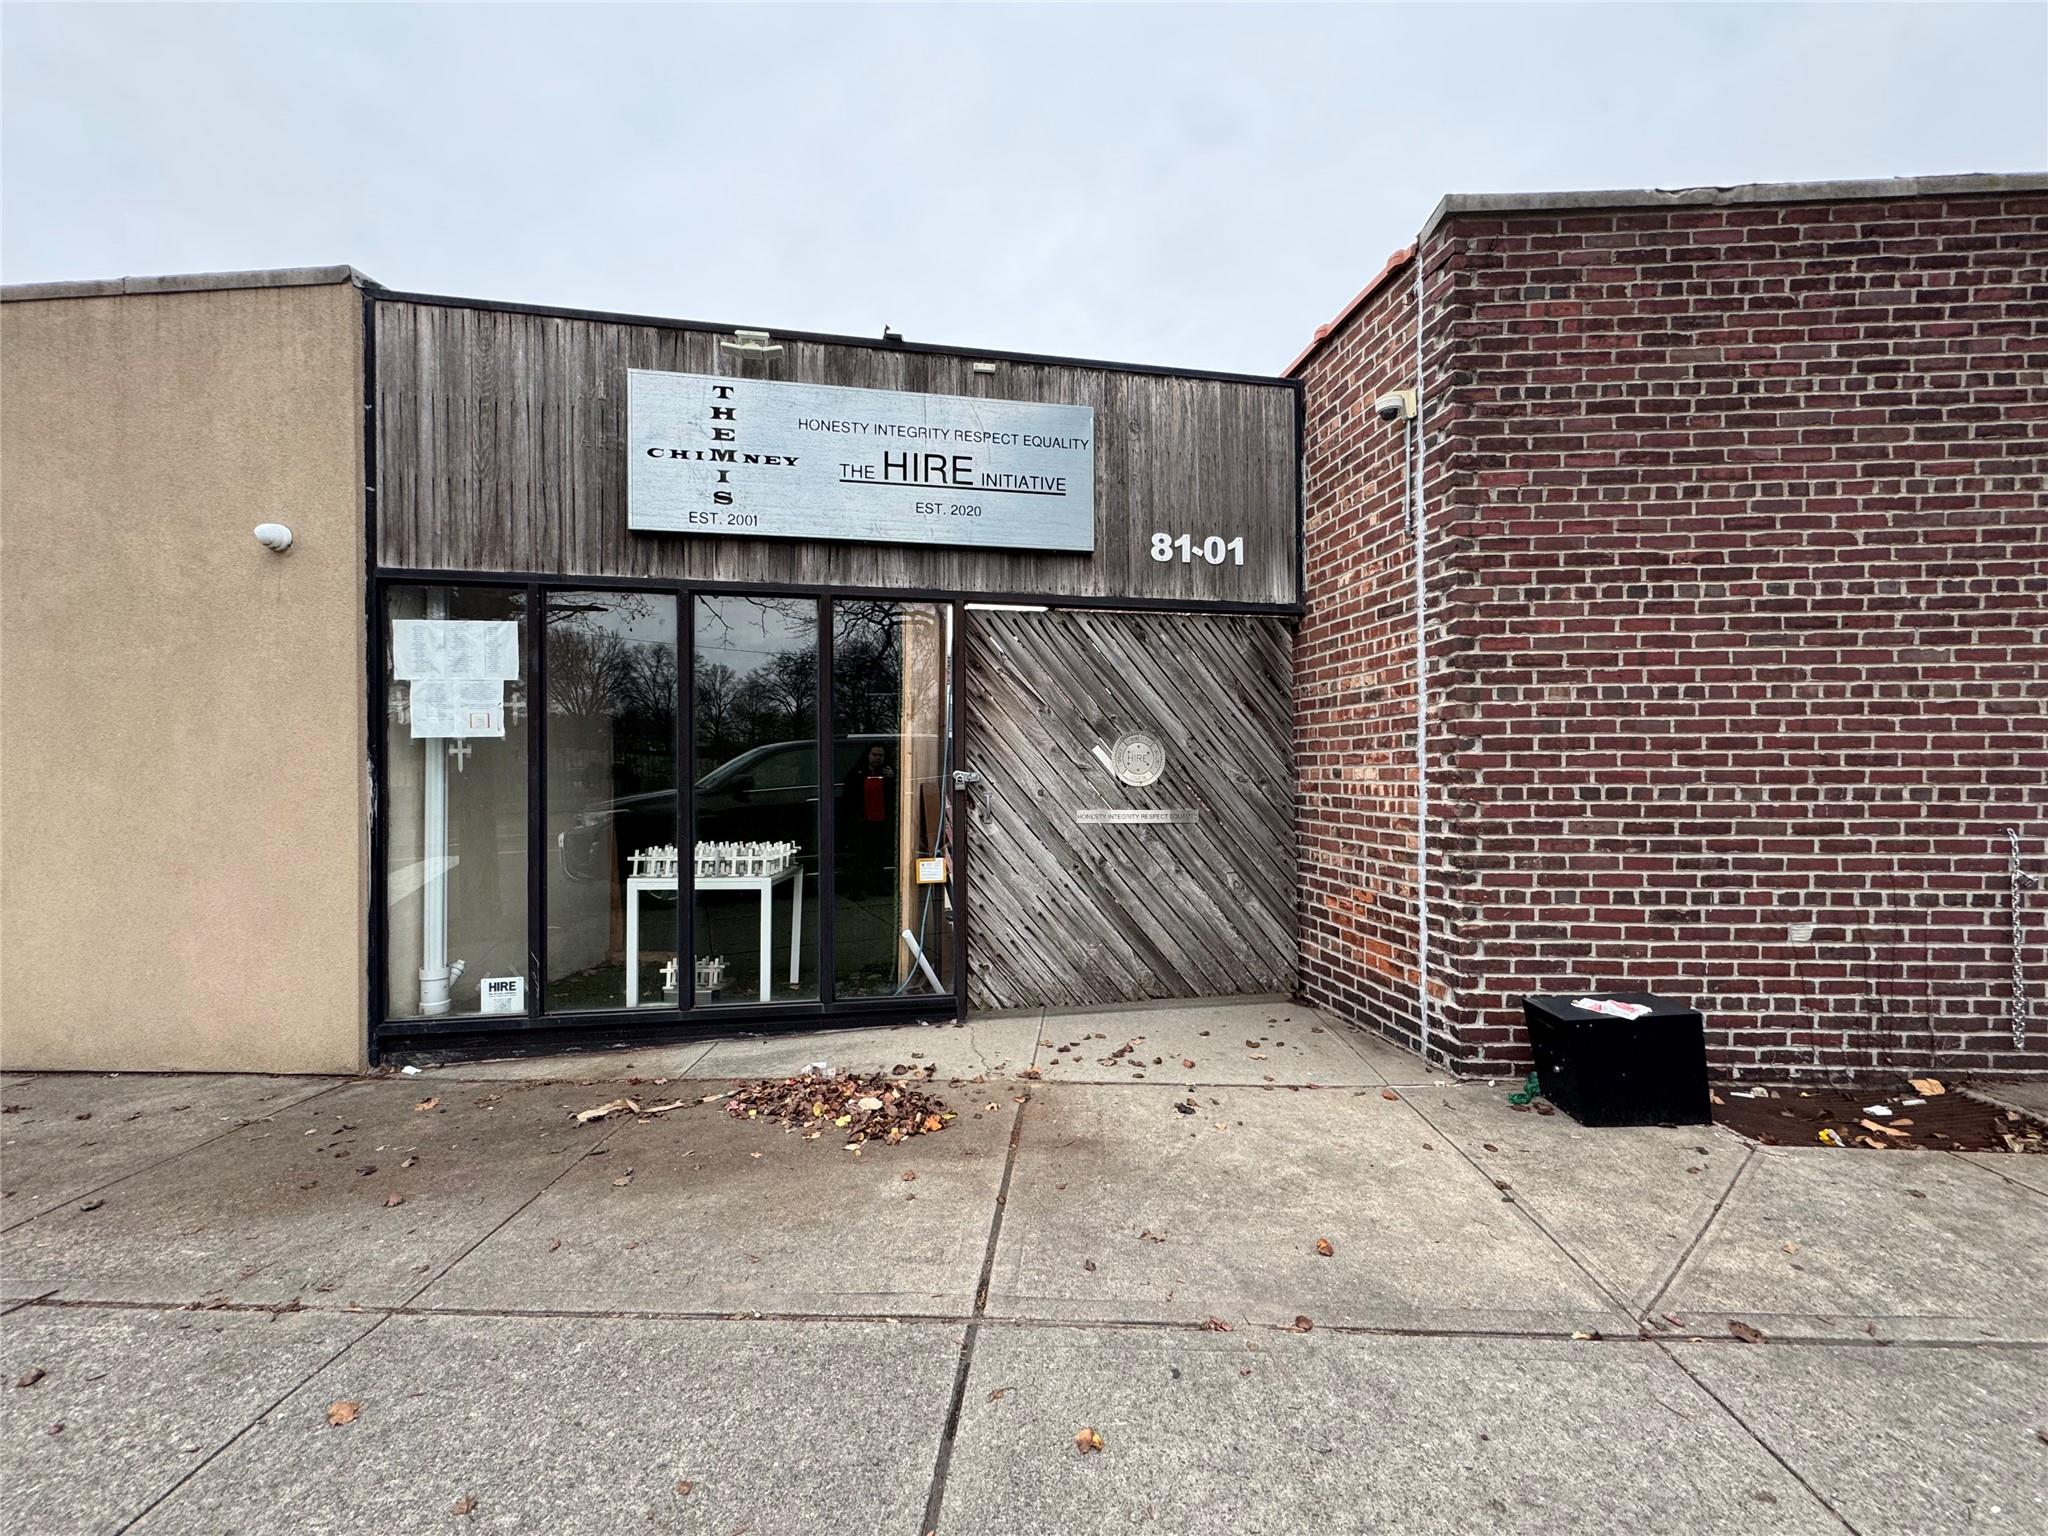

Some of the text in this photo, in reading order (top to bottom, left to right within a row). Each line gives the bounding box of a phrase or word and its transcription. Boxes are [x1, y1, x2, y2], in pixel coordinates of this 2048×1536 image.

[798, 418, 1089, 451] HONESTY INTEGRITY RESPECT EQUALITY
[709, 385, 738, 506] THEMIS
[646, 447, 800, 467] CHIMNEY
[839, 450, 1067, 492] THE HIRE INITIATIVE
[688, 511, 758, 527] EST. 2001
[915, 501, 982, 517] EST. 2020
[1150, 532, 1244, 566] 81-01
[1140, 812, 1169, 820] RESPECT
[1169, 812, 1198, 820] EQUT
[488, 981, 517, 992] HIRE
